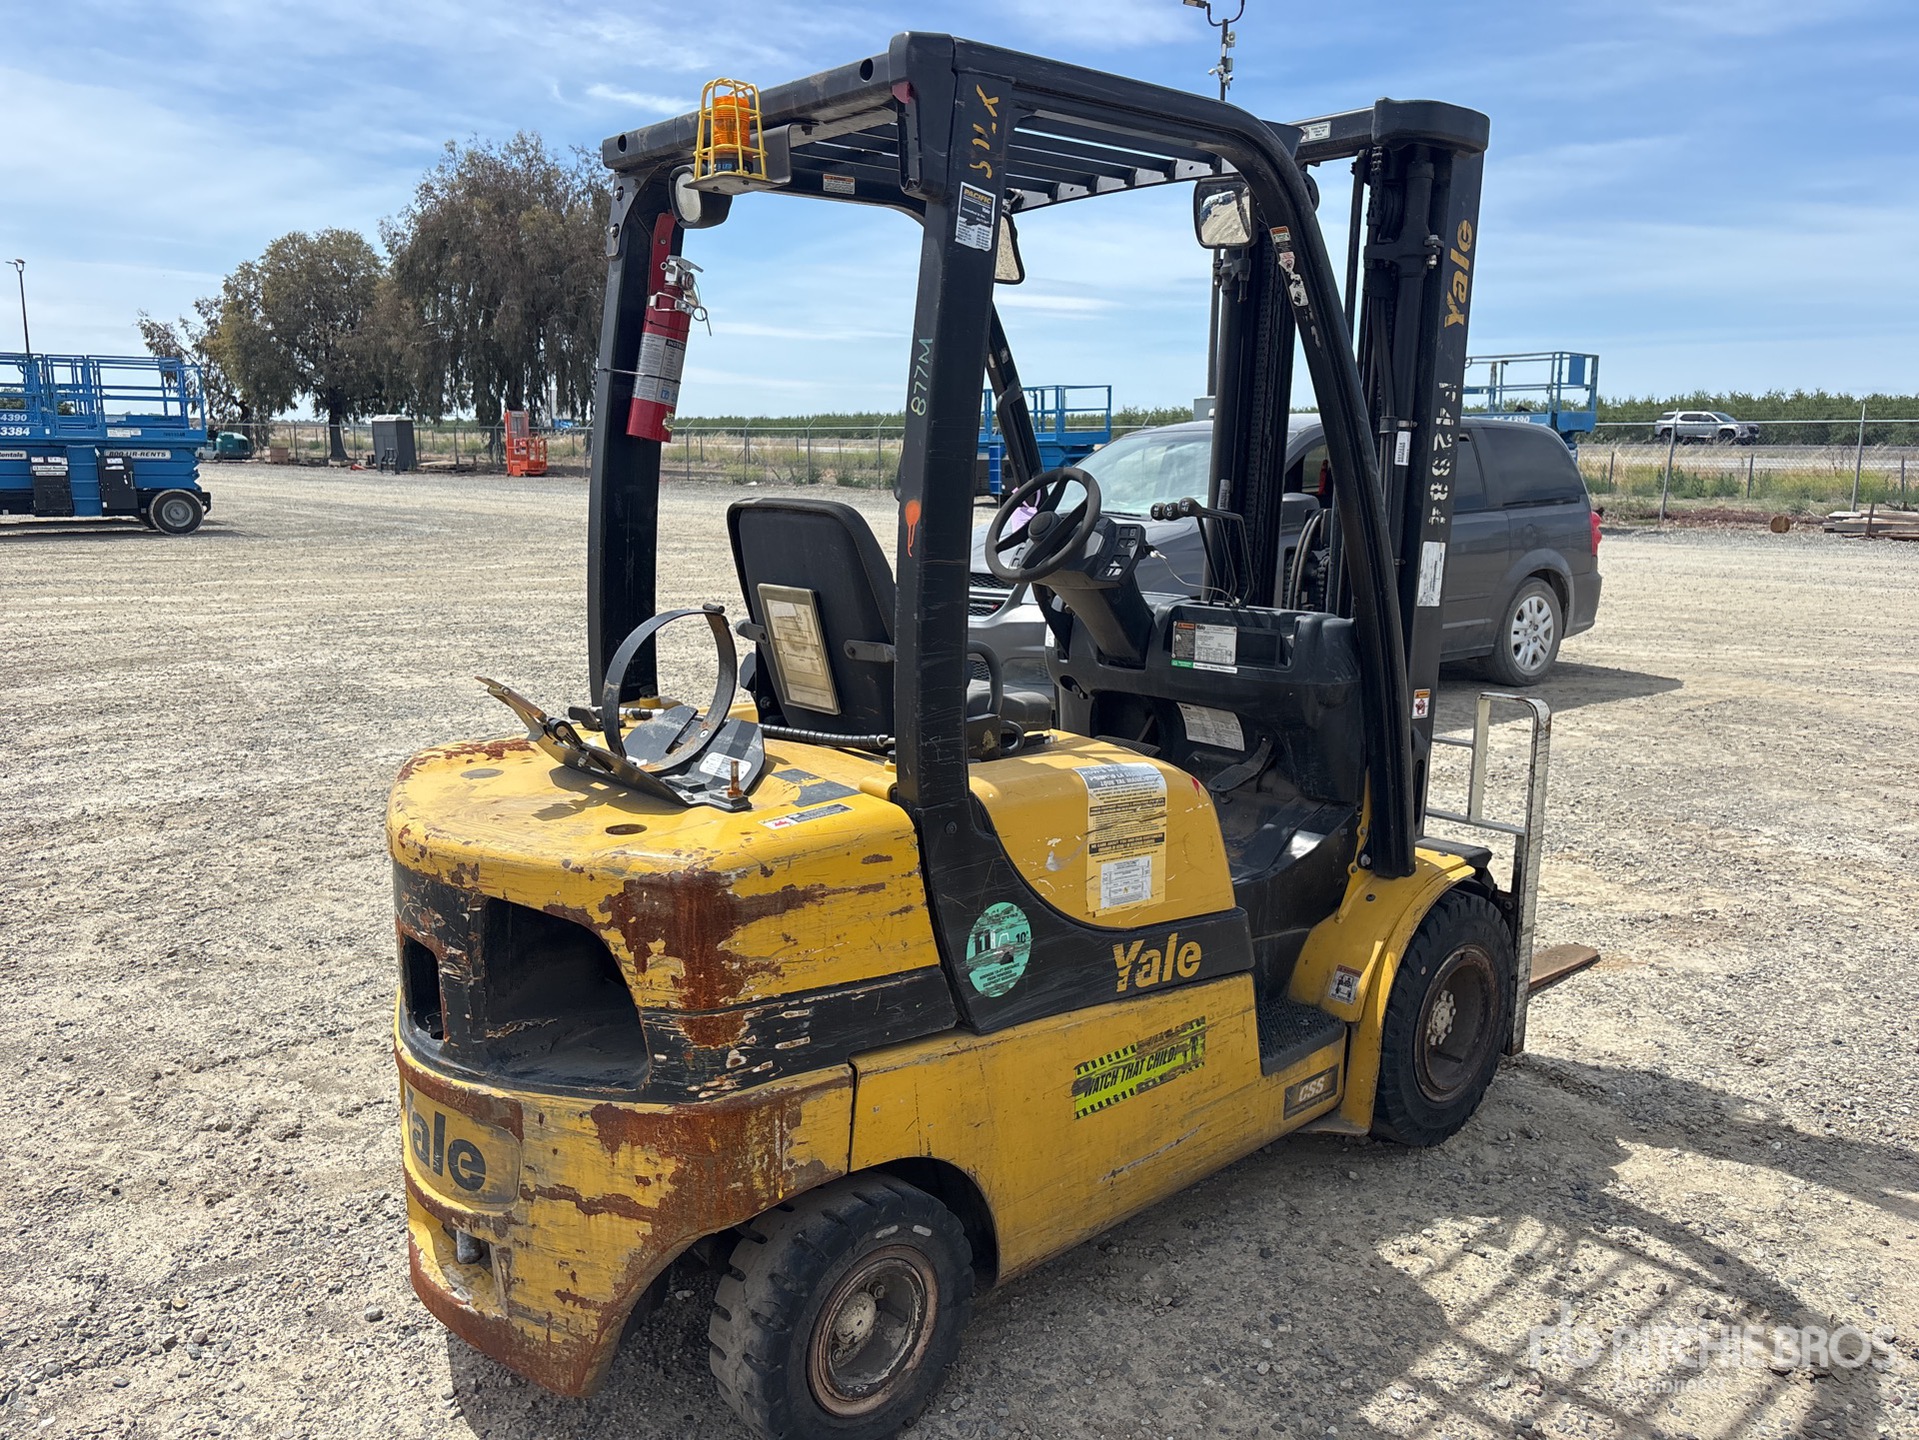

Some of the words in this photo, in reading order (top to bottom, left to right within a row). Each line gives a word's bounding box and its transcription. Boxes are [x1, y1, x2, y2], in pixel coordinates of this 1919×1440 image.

[963, 188, 992, 204] PACIFIC
[1444, 220, 1473, 328] Yale
[0, 426, 31, 437] 3384
[1112, 932, 1202, 993] Yale
[1120, 1058, 1146, 1082] THAT
